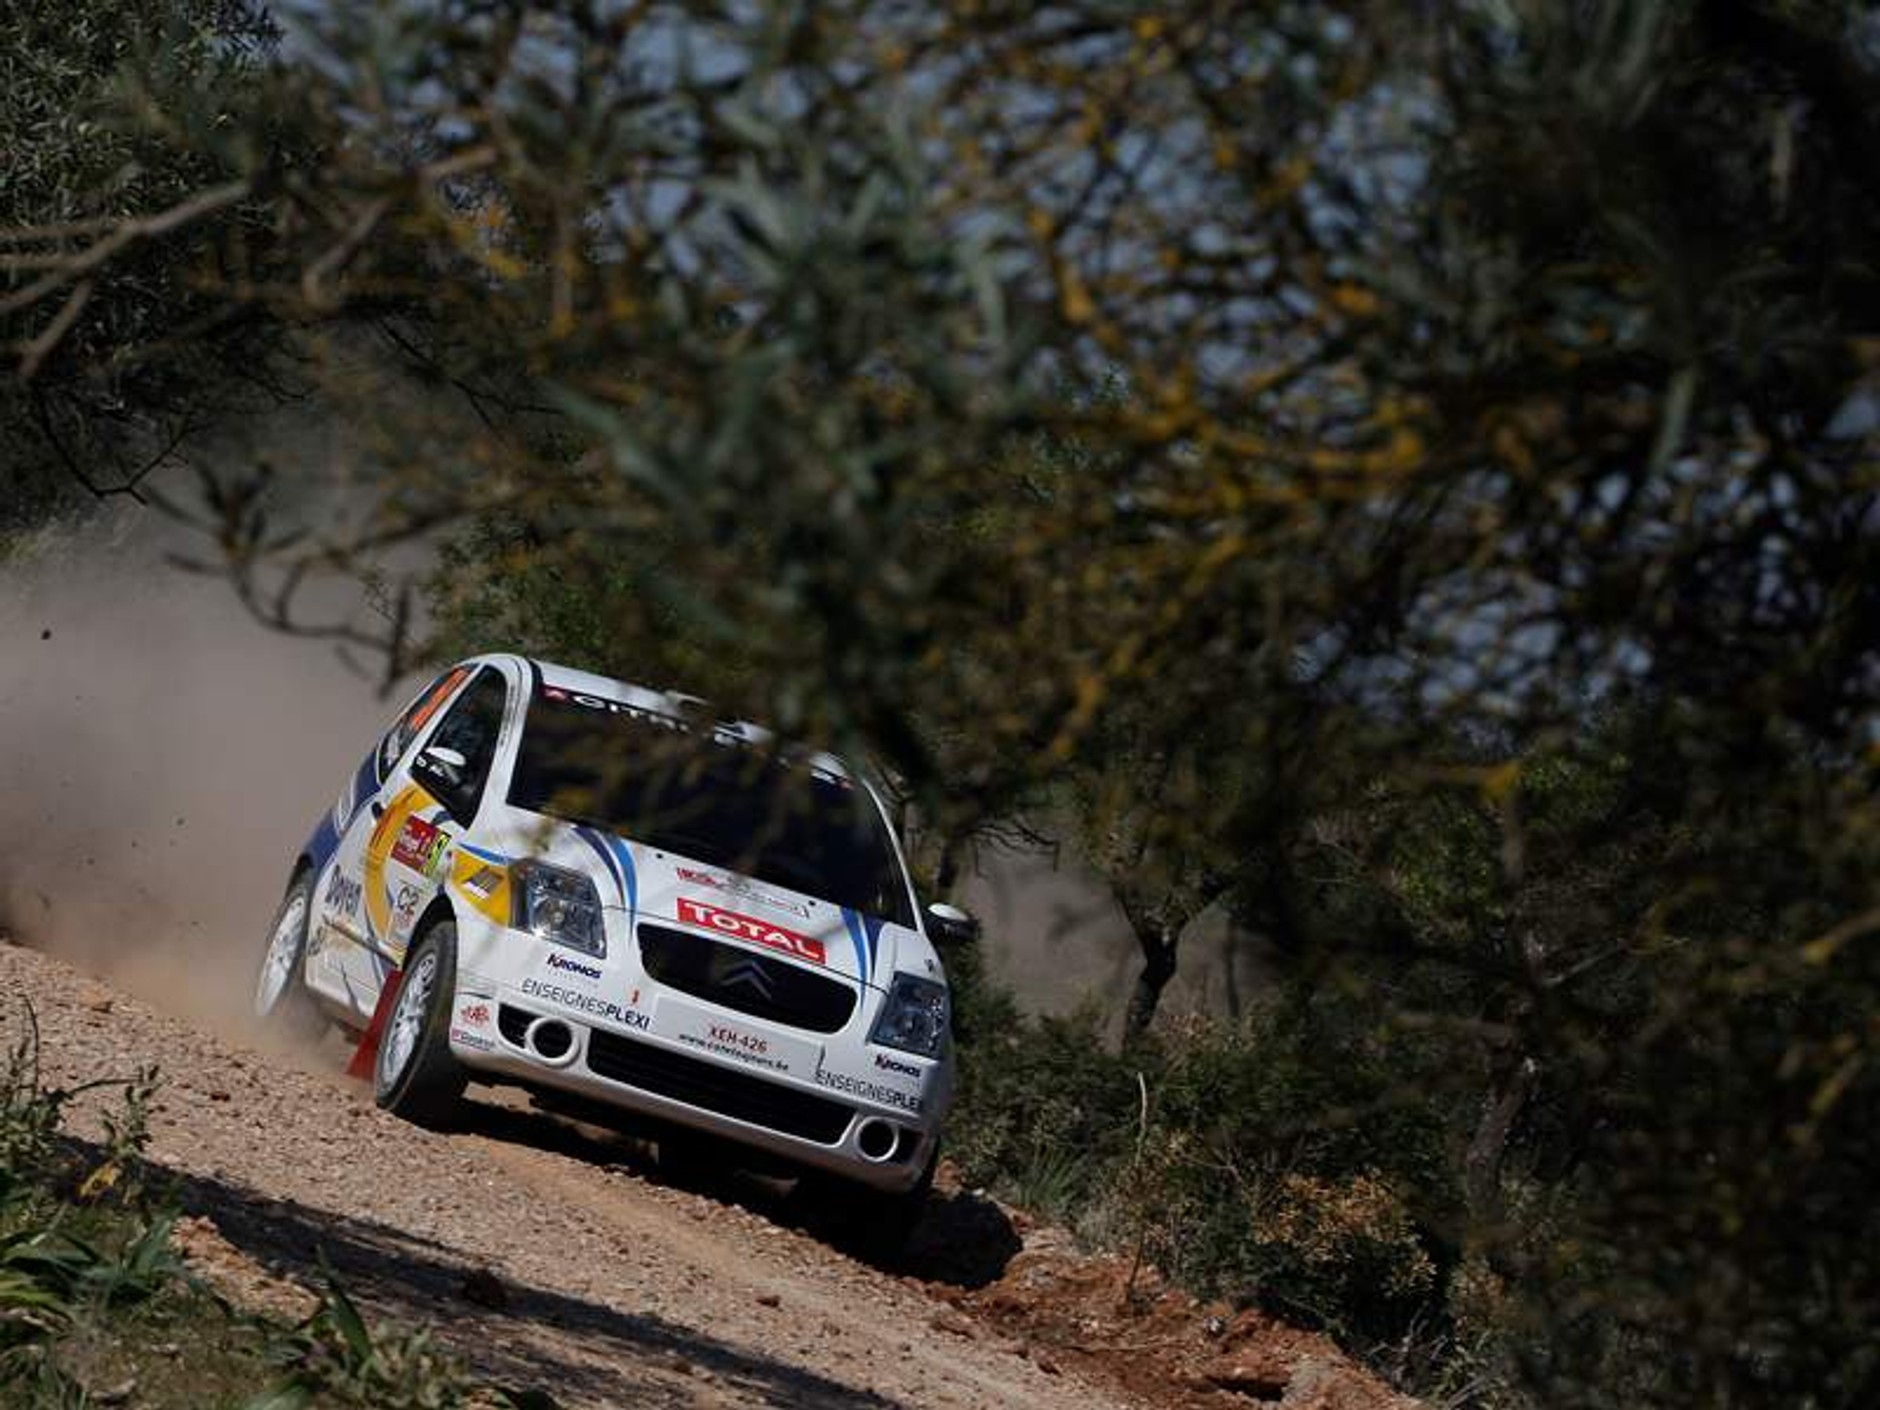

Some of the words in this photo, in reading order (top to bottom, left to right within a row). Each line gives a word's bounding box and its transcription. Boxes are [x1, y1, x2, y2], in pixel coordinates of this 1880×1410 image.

[684, 902, 820, 959] TOTAL
[521, 977, 650, 1030] ENSEIGNESPLEXI
[708, 1025, 768, 1053] XEH-426
